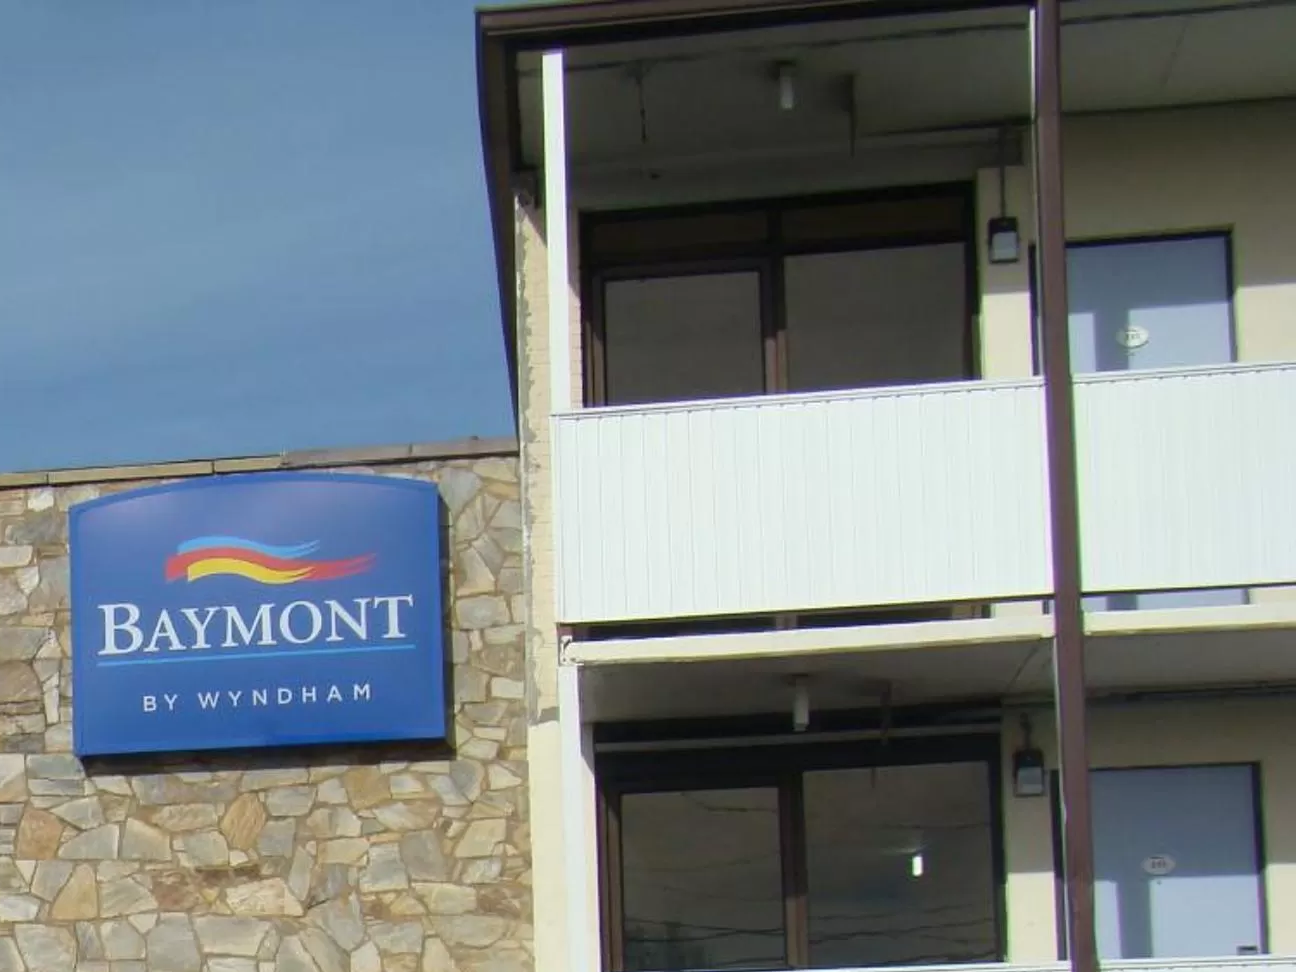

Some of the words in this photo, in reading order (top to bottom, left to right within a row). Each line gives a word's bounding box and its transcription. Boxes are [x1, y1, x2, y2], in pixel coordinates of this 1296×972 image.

[97, 594, 414, 656] BAYMONT
[142, 695, 178, 712] BY
[199, 683, 372, 710] WYNDHAM
